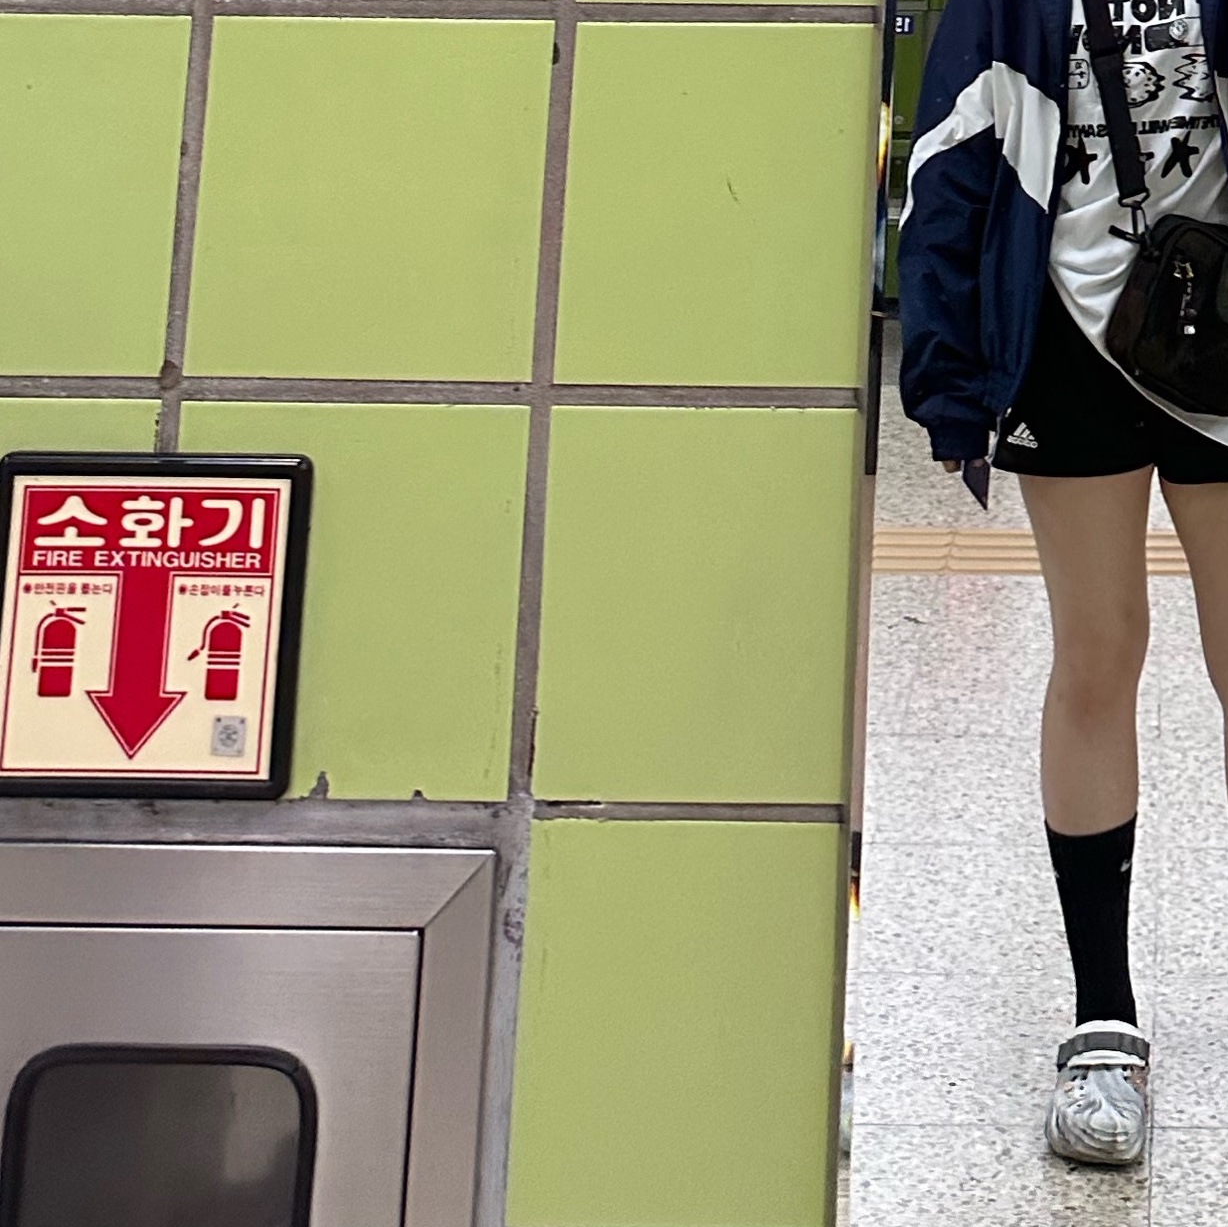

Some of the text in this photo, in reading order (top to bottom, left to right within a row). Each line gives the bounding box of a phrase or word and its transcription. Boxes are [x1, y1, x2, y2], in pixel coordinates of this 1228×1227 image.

[33, 494, 266, 549] 소화기
[32, 550, 262, 569] FIRE EXTINGUISHER
